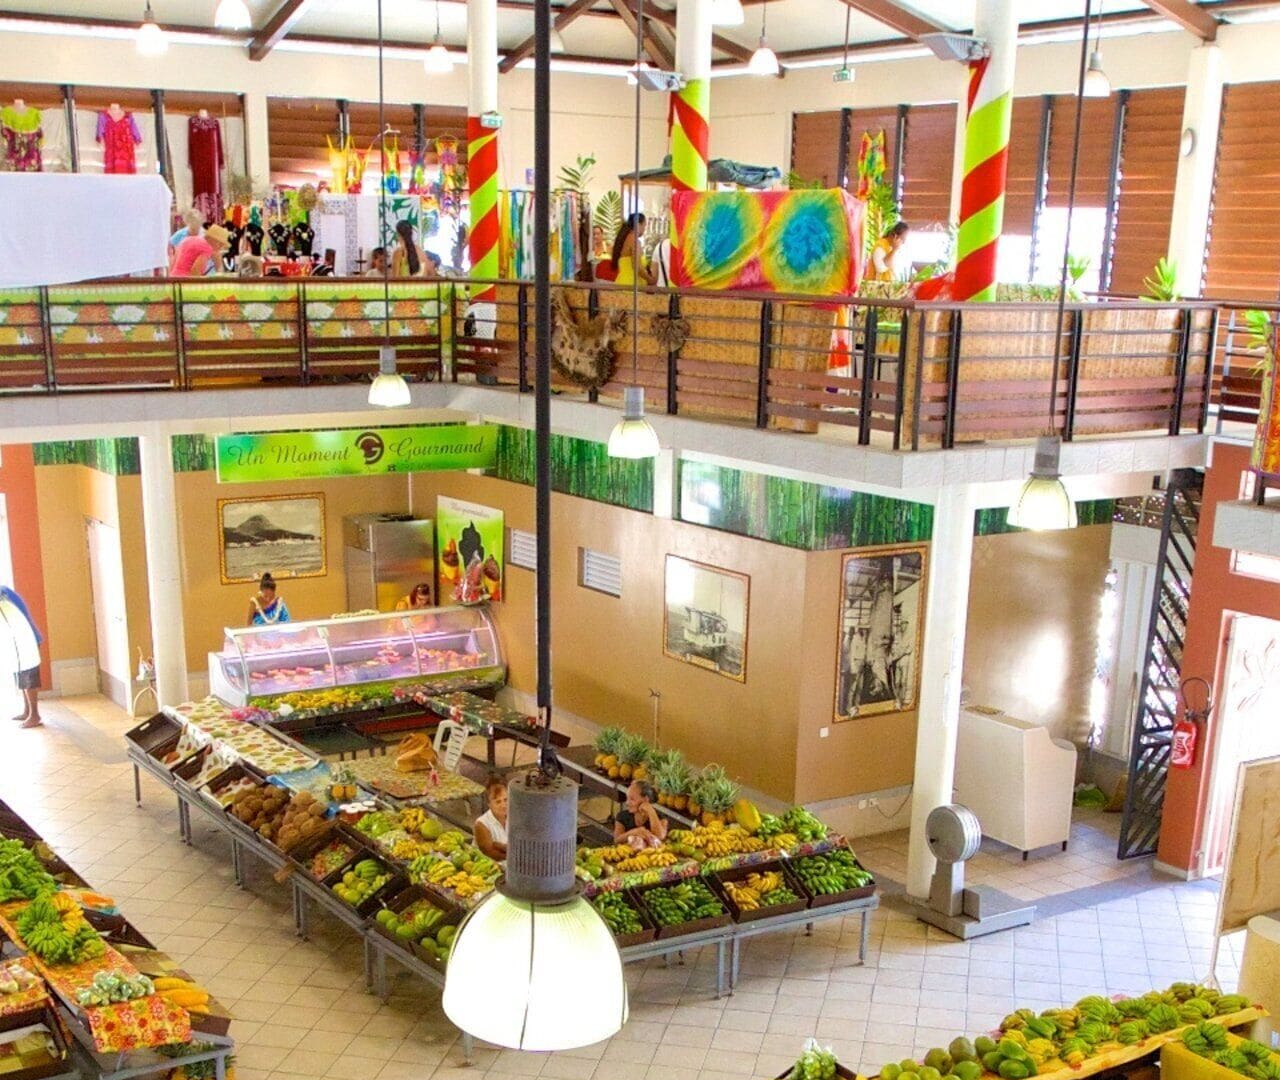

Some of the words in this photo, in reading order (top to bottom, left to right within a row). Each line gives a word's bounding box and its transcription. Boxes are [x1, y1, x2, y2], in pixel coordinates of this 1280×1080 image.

[228, 445, 265, 466] Un
[272, 445, 350, 464] Moment
[389, 436, 484, 459] Gourmand
